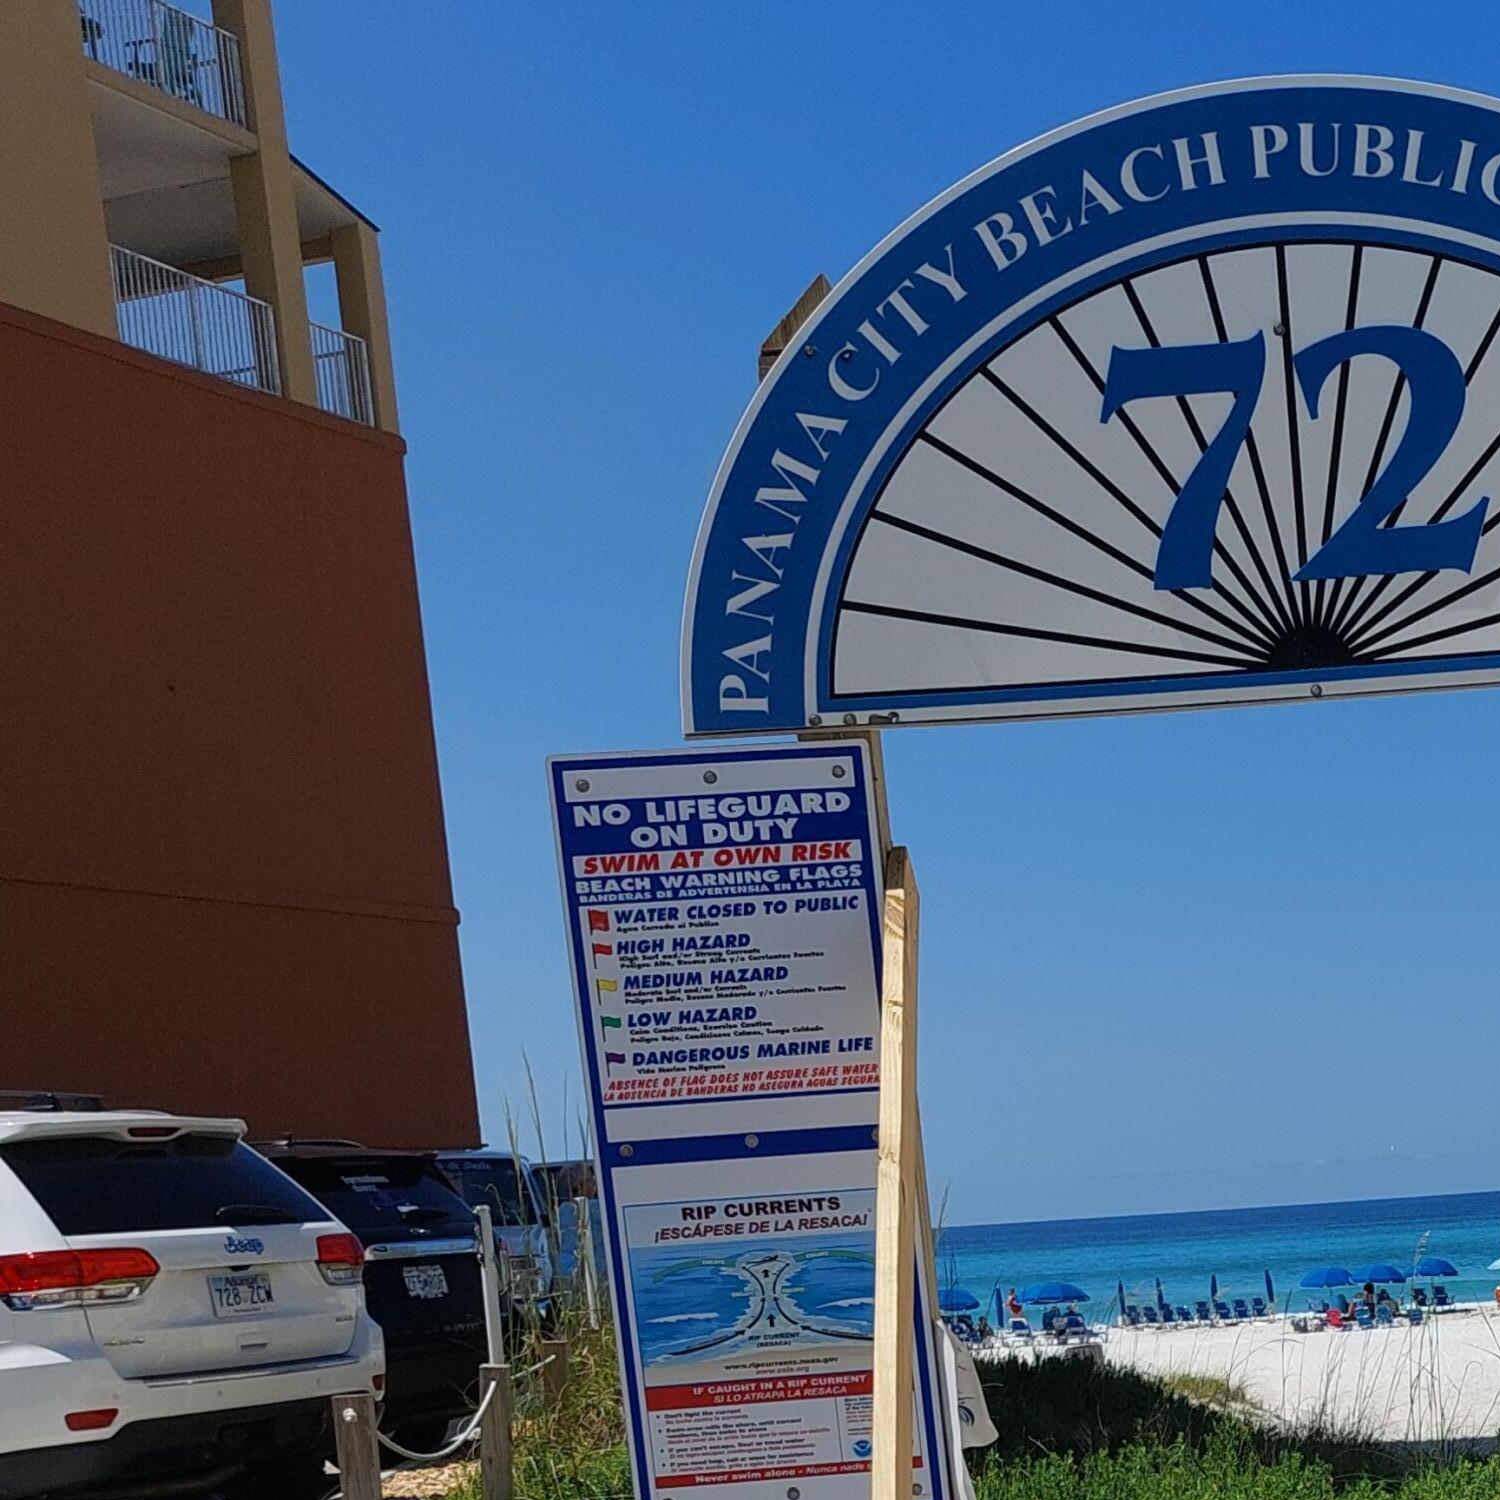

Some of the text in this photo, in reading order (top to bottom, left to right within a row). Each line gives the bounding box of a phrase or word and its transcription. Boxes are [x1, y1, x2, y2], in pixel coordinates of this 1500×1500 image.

[719, 412, 848, 714] PANAMA
[828, 243, 968, 401] CITY
[973, 131, 1227, 272] BEACH
[1100, 325, 1491, 590] 72
[574, 792, 851, 827] NO LIFEGUARD
[630, 818, 799, 848] ON DUTY
[584, 842, 852, 874] SWIM AT OWN RISK
[575, 865, 862, 893] BEACH WARNING FLAGS
[580, 893, 651, 904] BANDERAS
[817, 878, 860, 887] PLAYA
[614, 896, 858, 924] WATER CLOSED TO PUBLIC
[617, 934, 751, 954] HIGH HAZARD
[624, 967, 789, 990] MEDIUM HAZARD
[627, 1007, 757, 1027] LOW HAZARD
[633, 1037, 873, 1066] DANGEROUS MARINE LIFE
[609, 1064, 878, 1090] ABSENCE OF FLAG DOES NOT ASSURE SAFE WATER
[681, 1197, 841, 1221] RIP CURRENTS
[655, 1214, 868, 1243] ¡ESCÁPESE DE LA RESACA!
[224, 1236, 264, 1255] Jeep
[693, 1375, 867, 1395] IF CAUGHT IN A RIP CURRENT
[727, 1394, 742, 1402] LO
[744, 1391, 785, 1401] ATRAPA
[787, 1390, 801, 1398] LA
[803, 1386, 847, 1396] RESACA
[695, 1468, 795, 1484] Never swim alone
